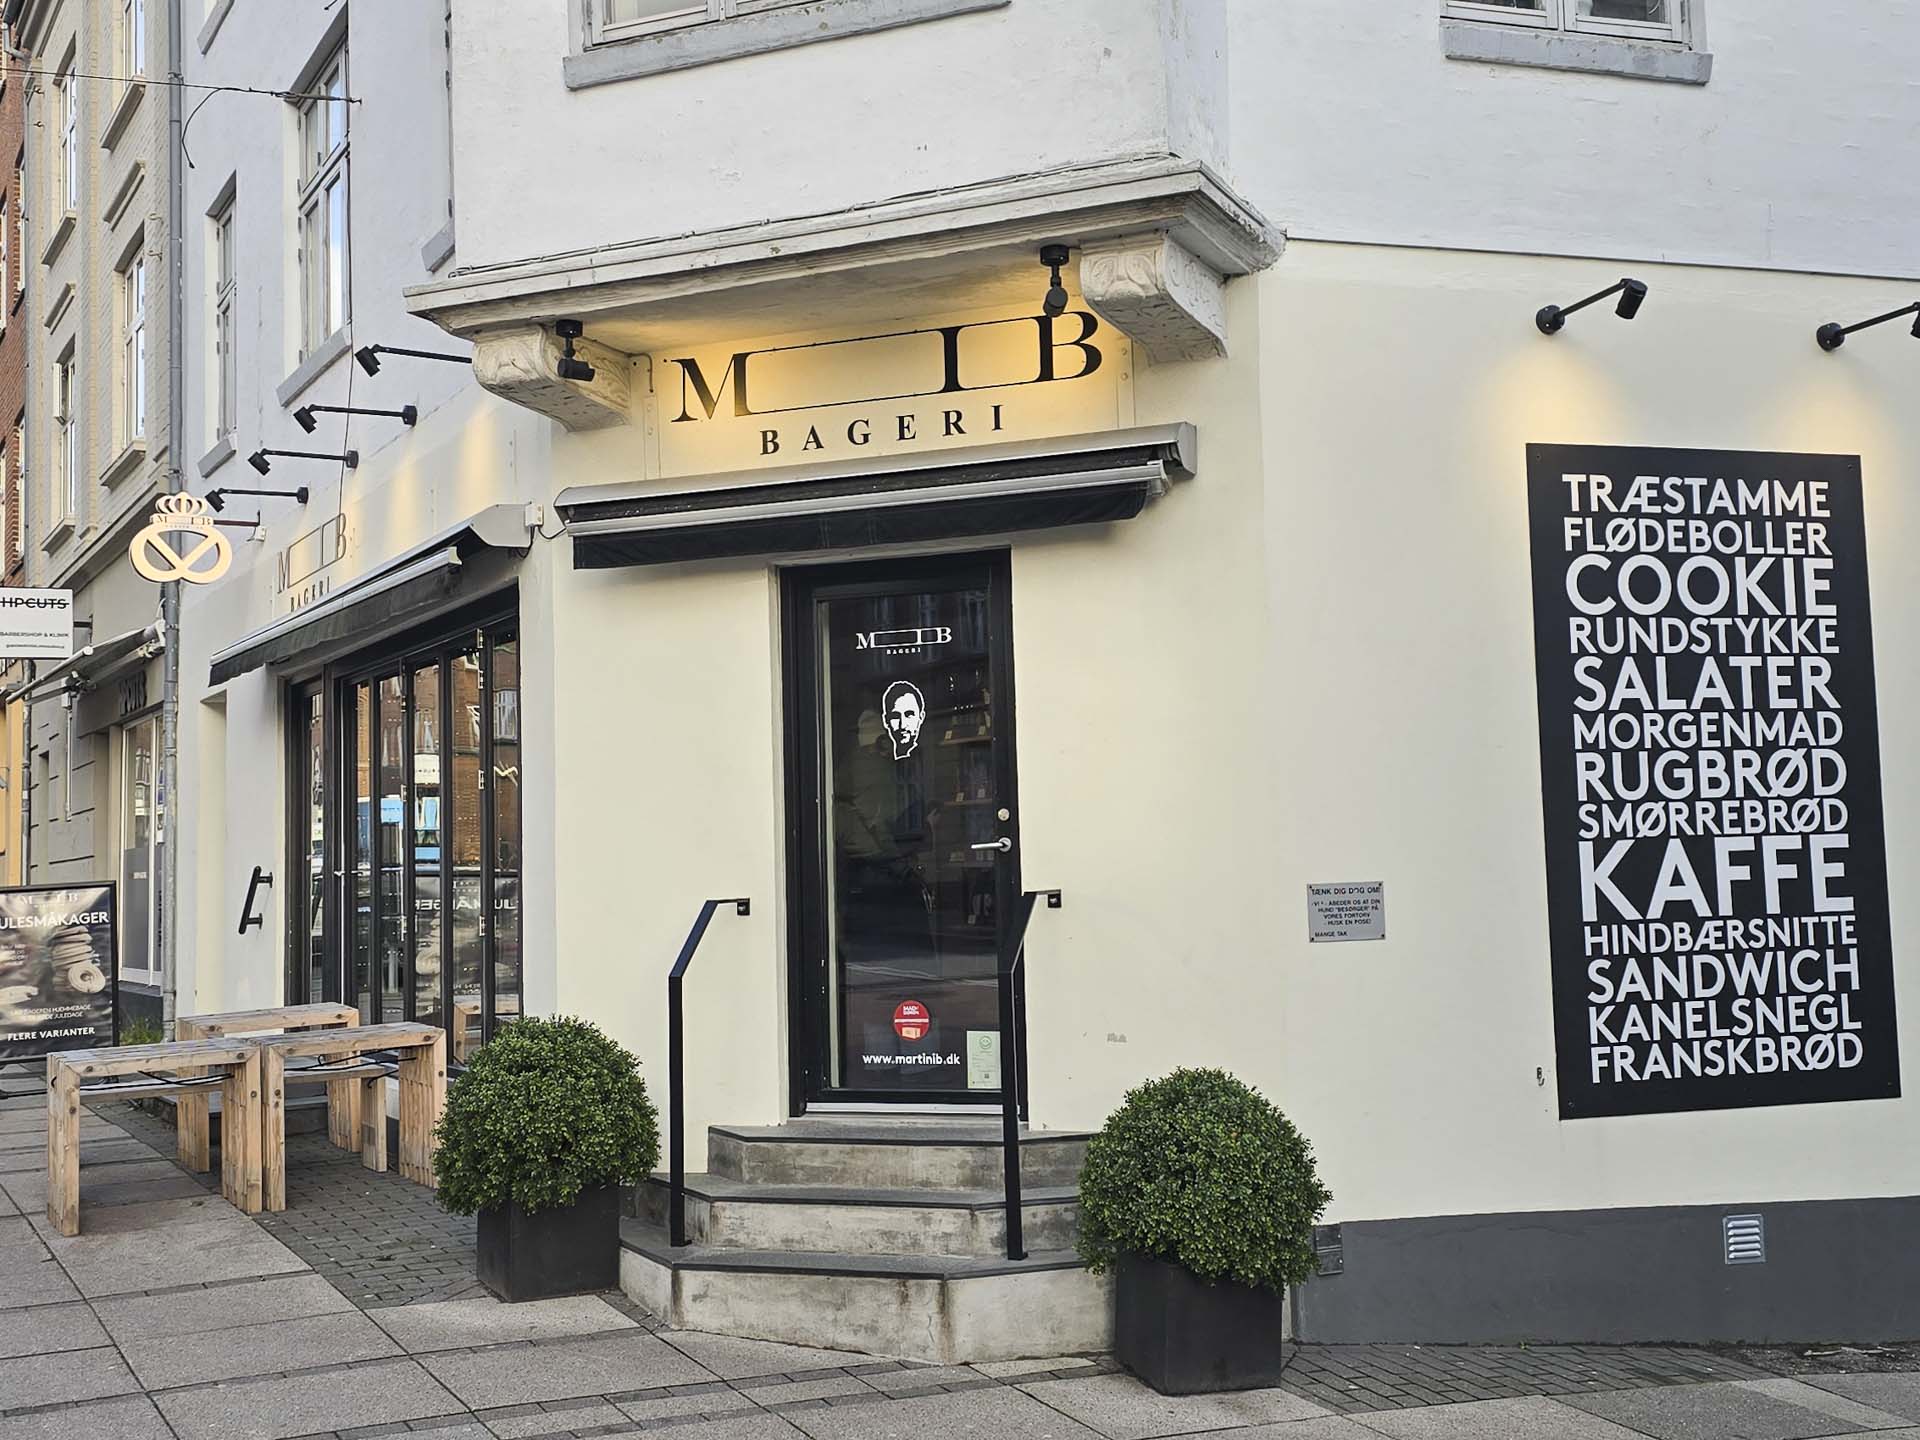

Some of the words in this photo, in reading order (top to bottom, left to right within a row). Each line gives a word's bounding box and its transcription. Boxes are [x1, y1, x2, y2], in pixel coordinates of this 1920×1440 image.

[759, 404, 1003, 456] BAGERI
[1561, 473, 1831, 518] TRÆSTAMME
[1563, 516, 1833, 556] FLØDEBOLLER
[1565, 552, 1838, 617] COOKIE
[1569, 616, 1840, 655] RUNDSTYKKE
[1573, 655, 1842, 712] SALATER
[1573, 710, 1844, 750] MORGENMAD
[1576, 748, 1848, 802] RUGBRØD
[1578, 798, 1849, 839] SMØRREBRØD
[1578, 833, 1855, 922] KAFFE
[1584, 915, 1858, 956] HINDBÆRSNITTE
[1587, 948, 1861, 1005] SANDWICH
[7, 1031, 37, 1041] FLERE
[39, 1027, 96, 1039] VARIANTER
[1588, 993, 1862, 1045] KANELSNEGL
[862, 1053, 961, 1065] www.martinib.dk
[1590, 1032, 1864, 1084] FRANSKBRØD
